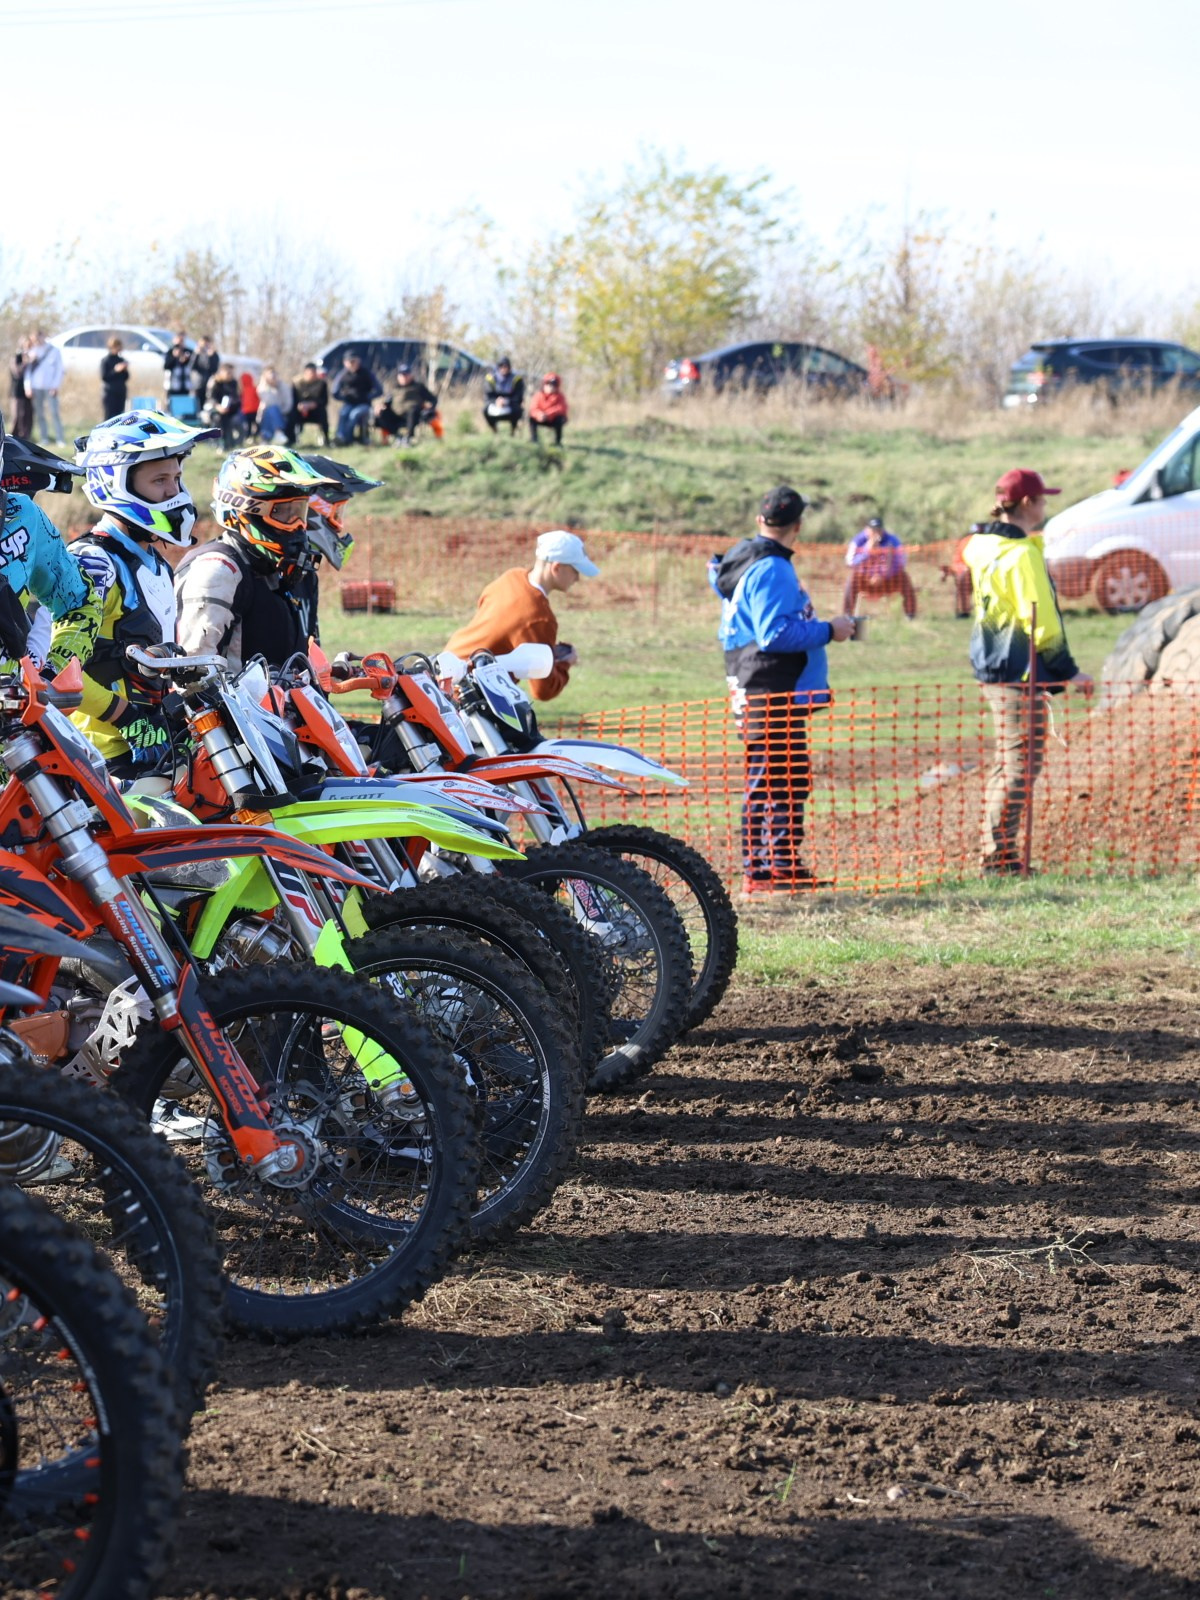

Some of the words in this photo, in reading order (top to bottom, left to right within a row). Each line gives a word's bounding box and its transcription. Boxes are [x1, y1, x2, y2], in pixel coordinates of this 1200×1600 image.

[0, 474, 32, 487] arks.
[108, 902, 131, 935] Racing
[126, 934, 162, 989] Suspension
[117, 899, 157, 960] Double
[155, 963, 174, 986] EE
[194, 1030, 215, 1062] brembo
[196, 1009, 265, 1121] DUNLOP
[218, 1075, 244, 1115] MOTOREX
